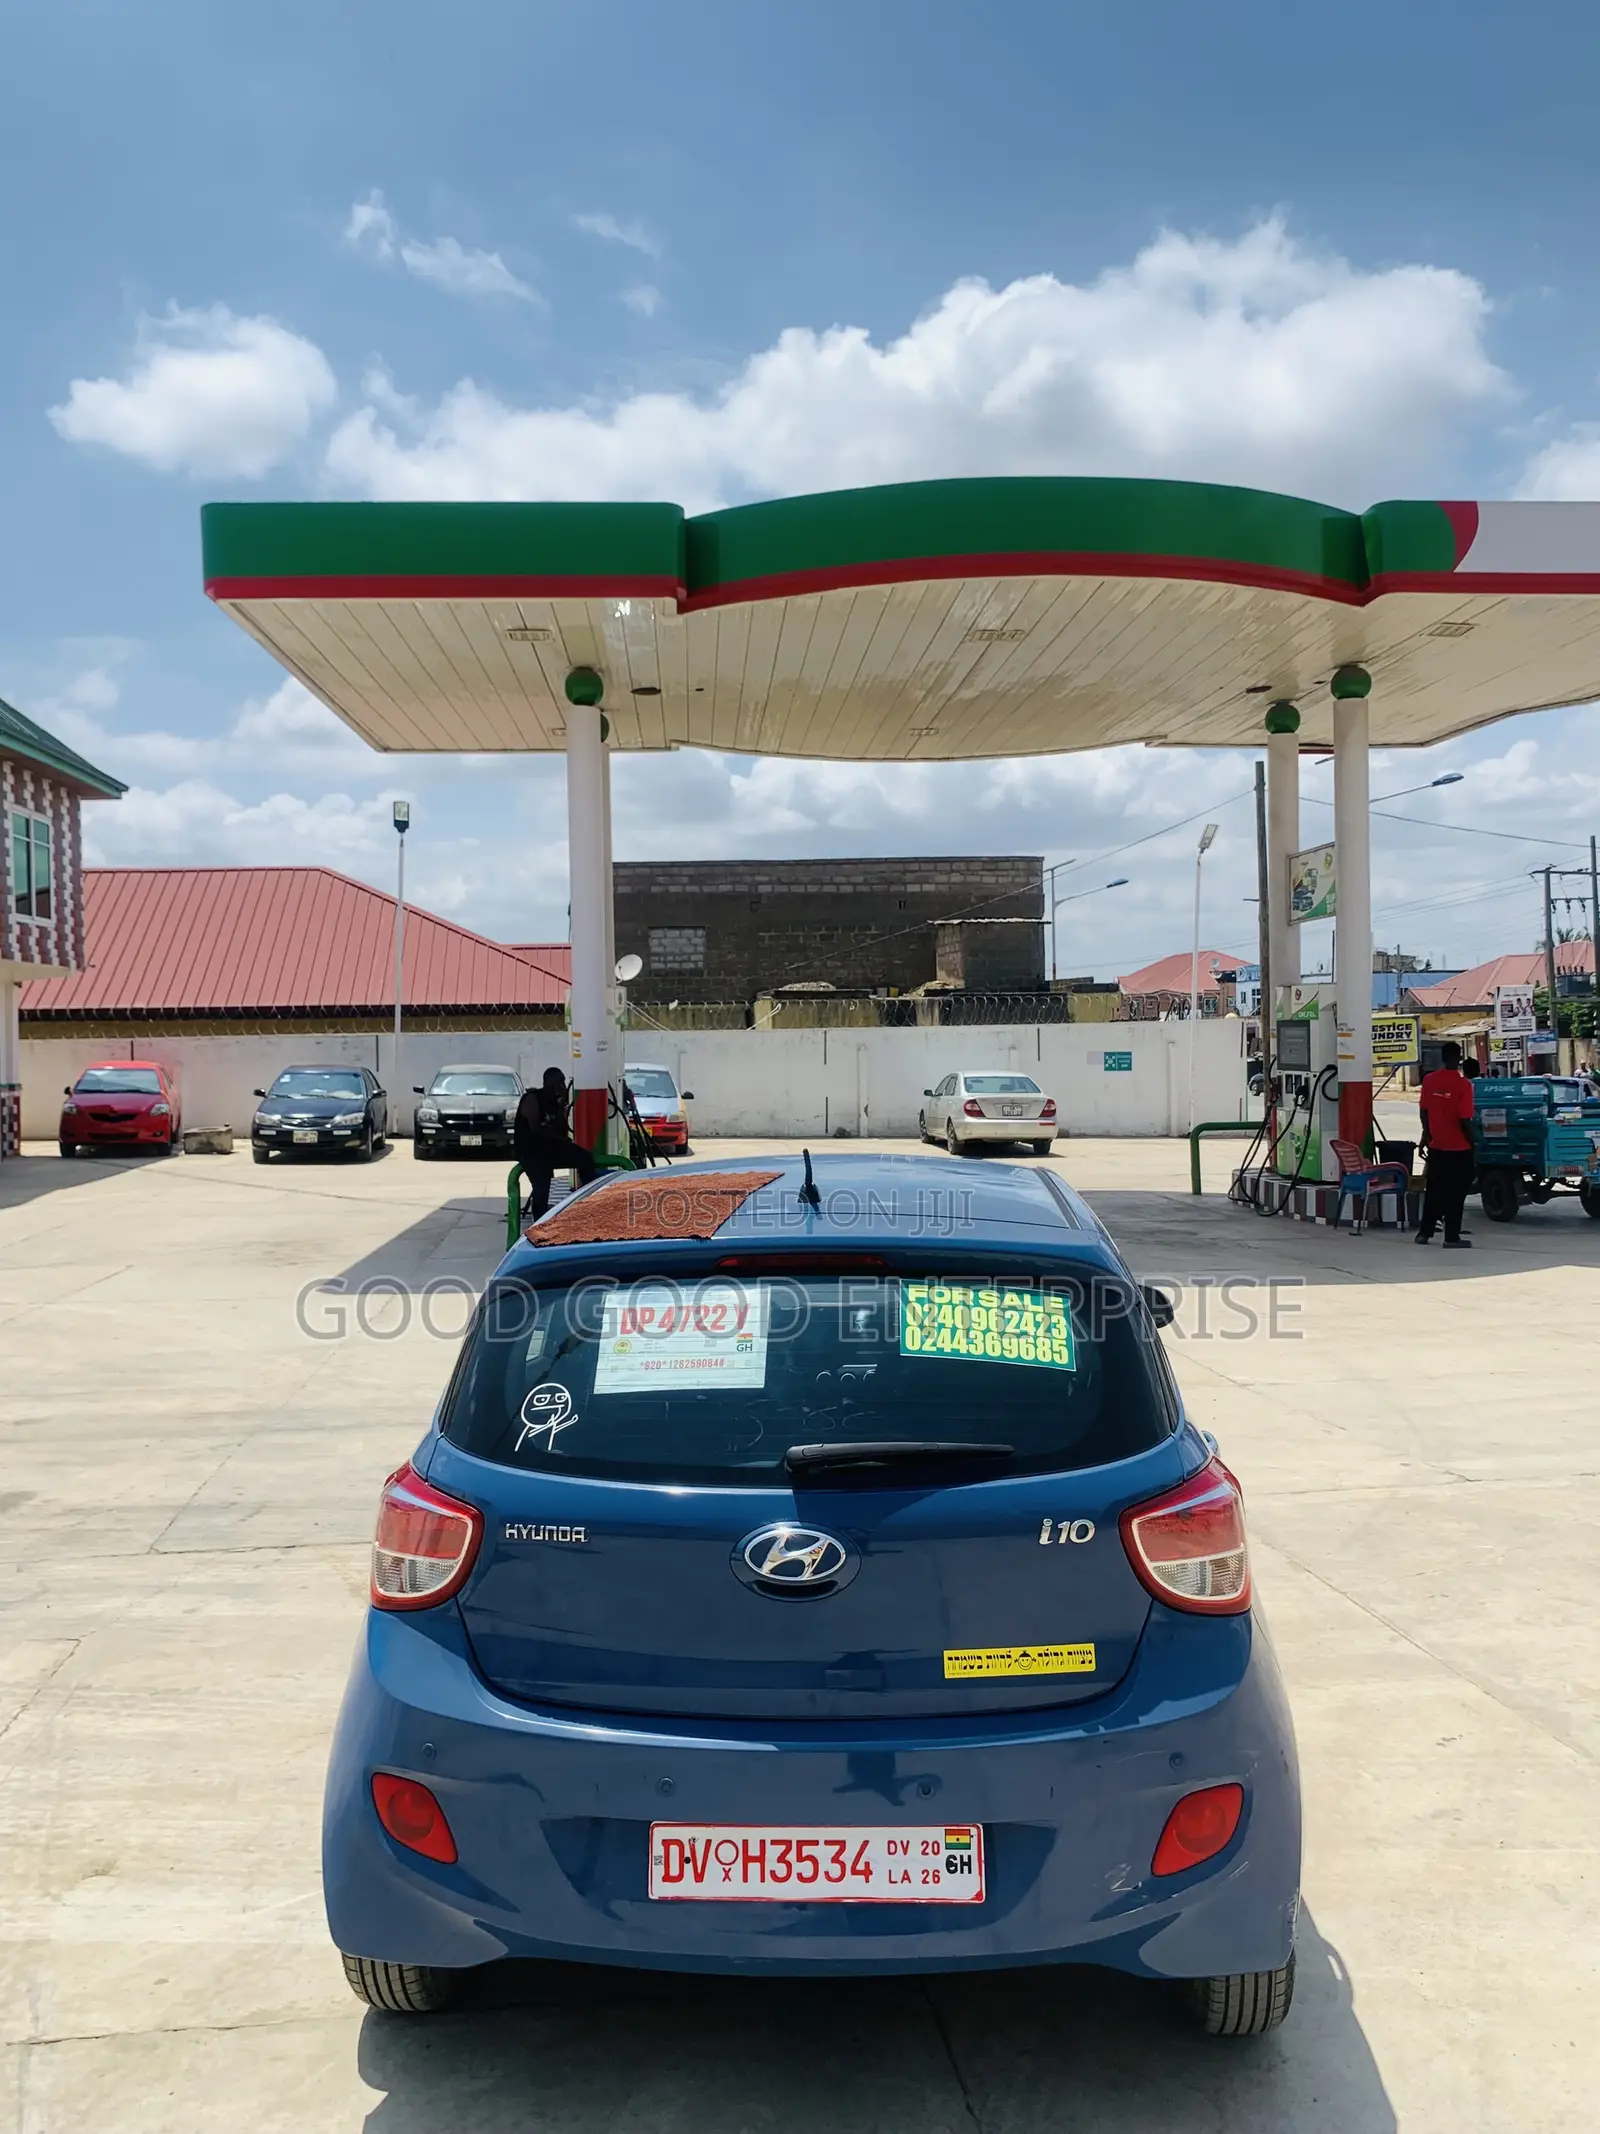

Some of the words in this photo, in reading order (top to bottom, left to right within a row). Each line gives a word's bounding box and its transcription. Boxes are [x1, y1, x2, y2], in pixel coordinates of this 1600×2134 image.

[1371, 1031, 1413, 1040] UNDRY
[1372, 1022, 1413, 1032] ESTIGE
[908, 1284, 974, 1306] FOR
[977, 1289, 1065, 1315] SALE
[620, 1306, 655, 1335] DP
[658, 1303, 727, 1333] 4722
[734, 1303, 751, 1330] Y
[905, 1302, 1068, 1340] 0240962423
[736, 1343, 753, 1352] GH
[904, 1325, 1069, 1365] 0244369685
[505, 1523, 589, 1543] HYUNDA
[1039, 1518, 1096, 1545] i10
[887, 1839, 910, 1857] DV
[920, 1839, 941, 1857] 20
[944, 1853, 973, 1875] GH
[888, 1868, 912, 1885] LA
[920, 1868, 941, 1885] 26
